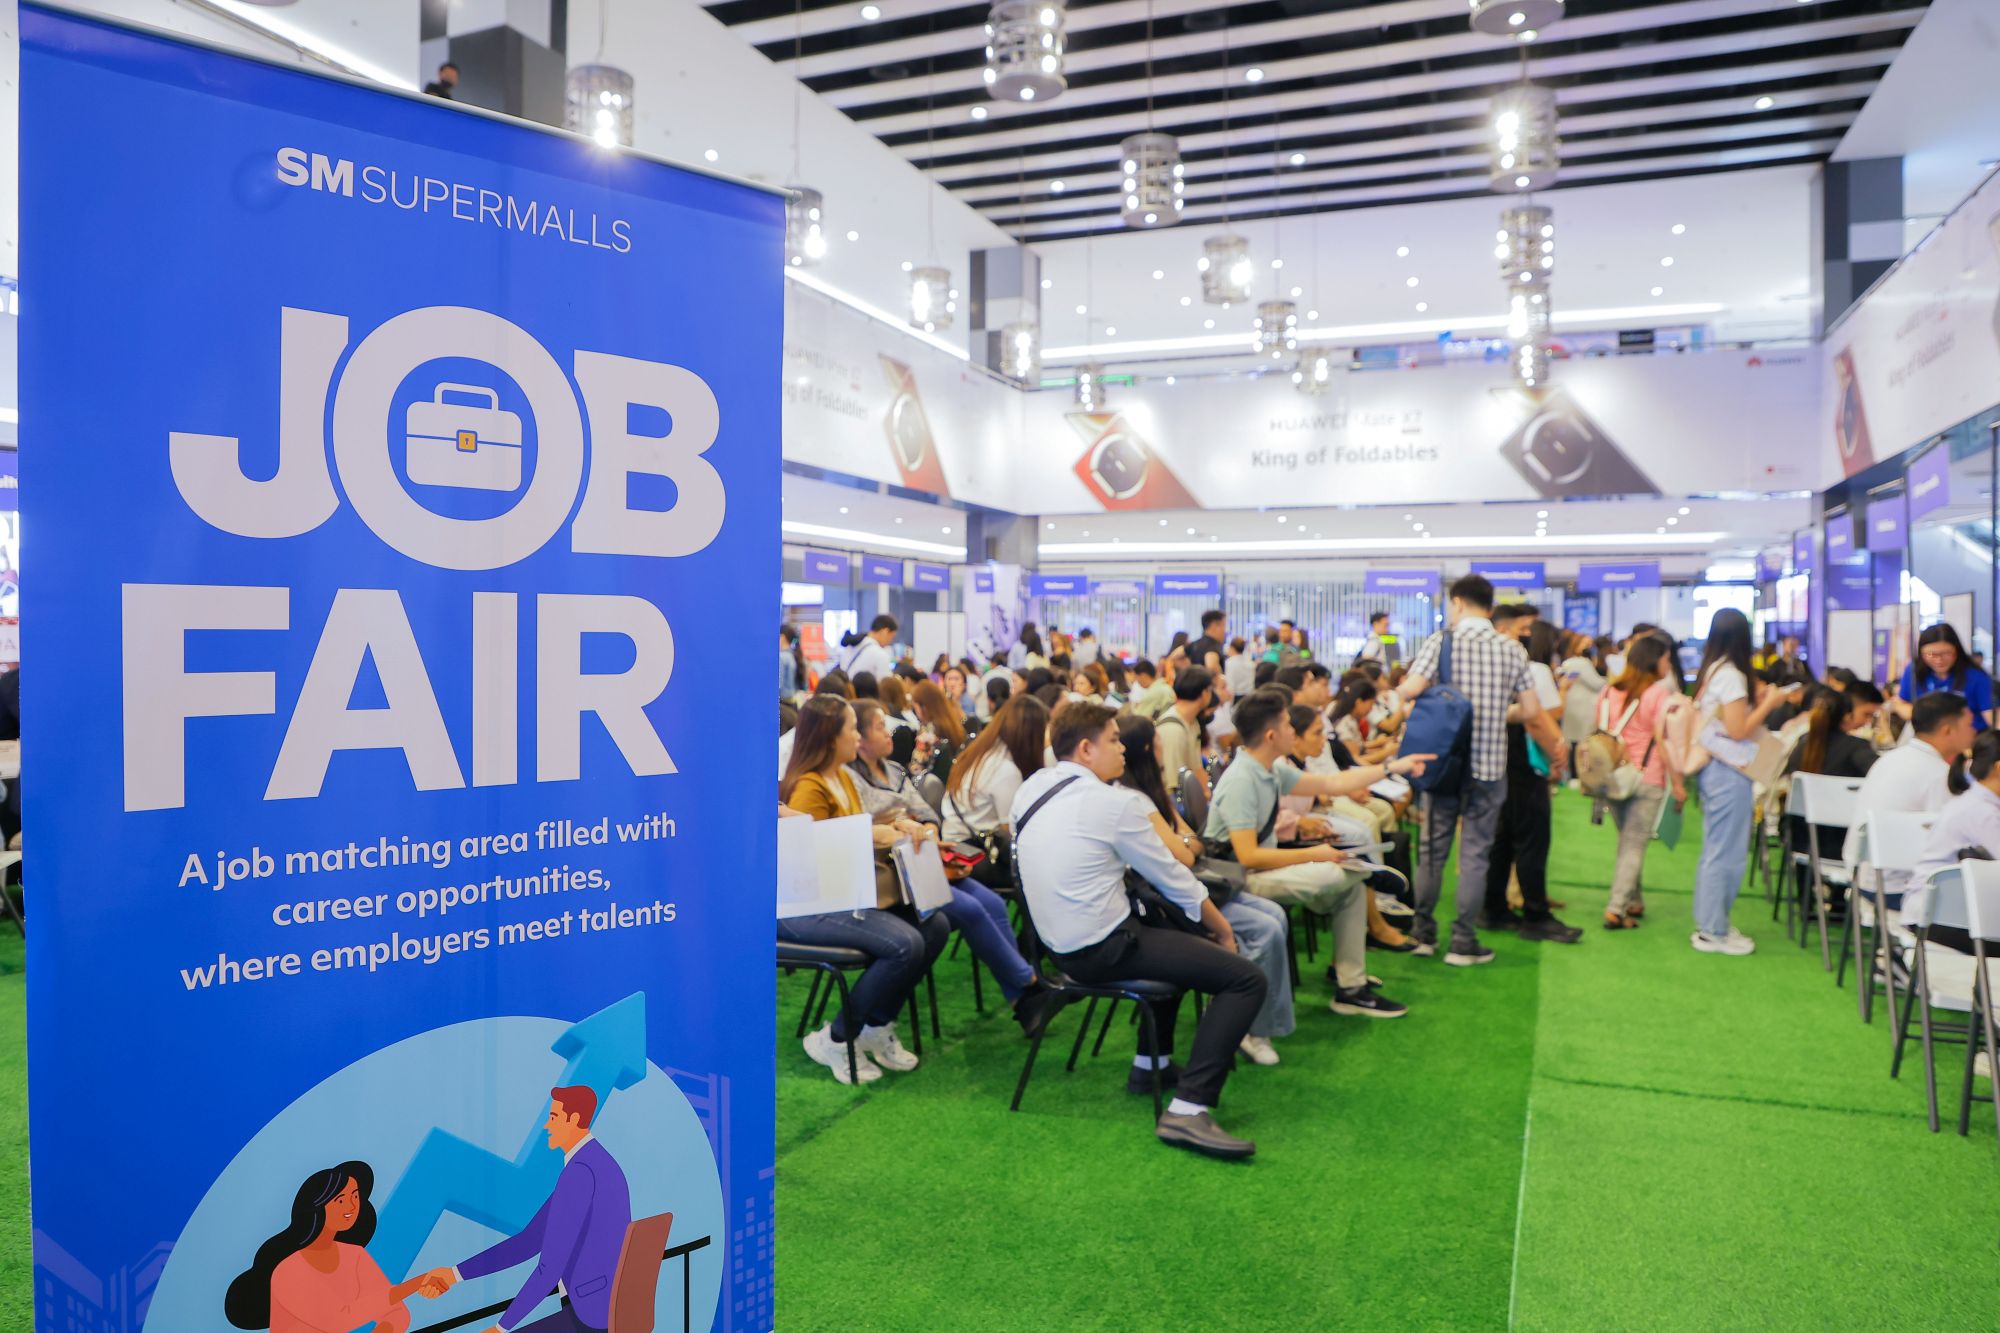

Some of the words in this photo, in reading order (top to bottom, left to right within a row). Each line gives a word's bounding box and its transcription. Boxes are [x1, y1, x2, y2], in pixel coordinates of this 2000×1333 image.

[276, 147, 354, 198] SM
[361, 166, 632, 253] SUPERMALLS
[169, 306, 727, 571] JOB
[1251, 448, 1299, 472] King
[1305, 445, 1328, 466] of
[1335, 443, 1440, 464] Foldables
[1269, 413, 1348, 431] HUAWEI
[121, 582, 679, 813] FAIR
[178, 853, 209, 887] A
[213, 847, 275, 891] job
[285, 836, 451, 869] matching
[459, 832, 528, 858] area
[535, 816, 609, 850] filled
[615, 812, 676, 843] with
[272, 894, 389, 926] career
[396, 866, 612, 918] opportunities,
[180, 953, 301, 990] where
[311, 928, 490, 972] employers
[498, 911, 573, 946] meet
[578, 900, 677, 933] talents
